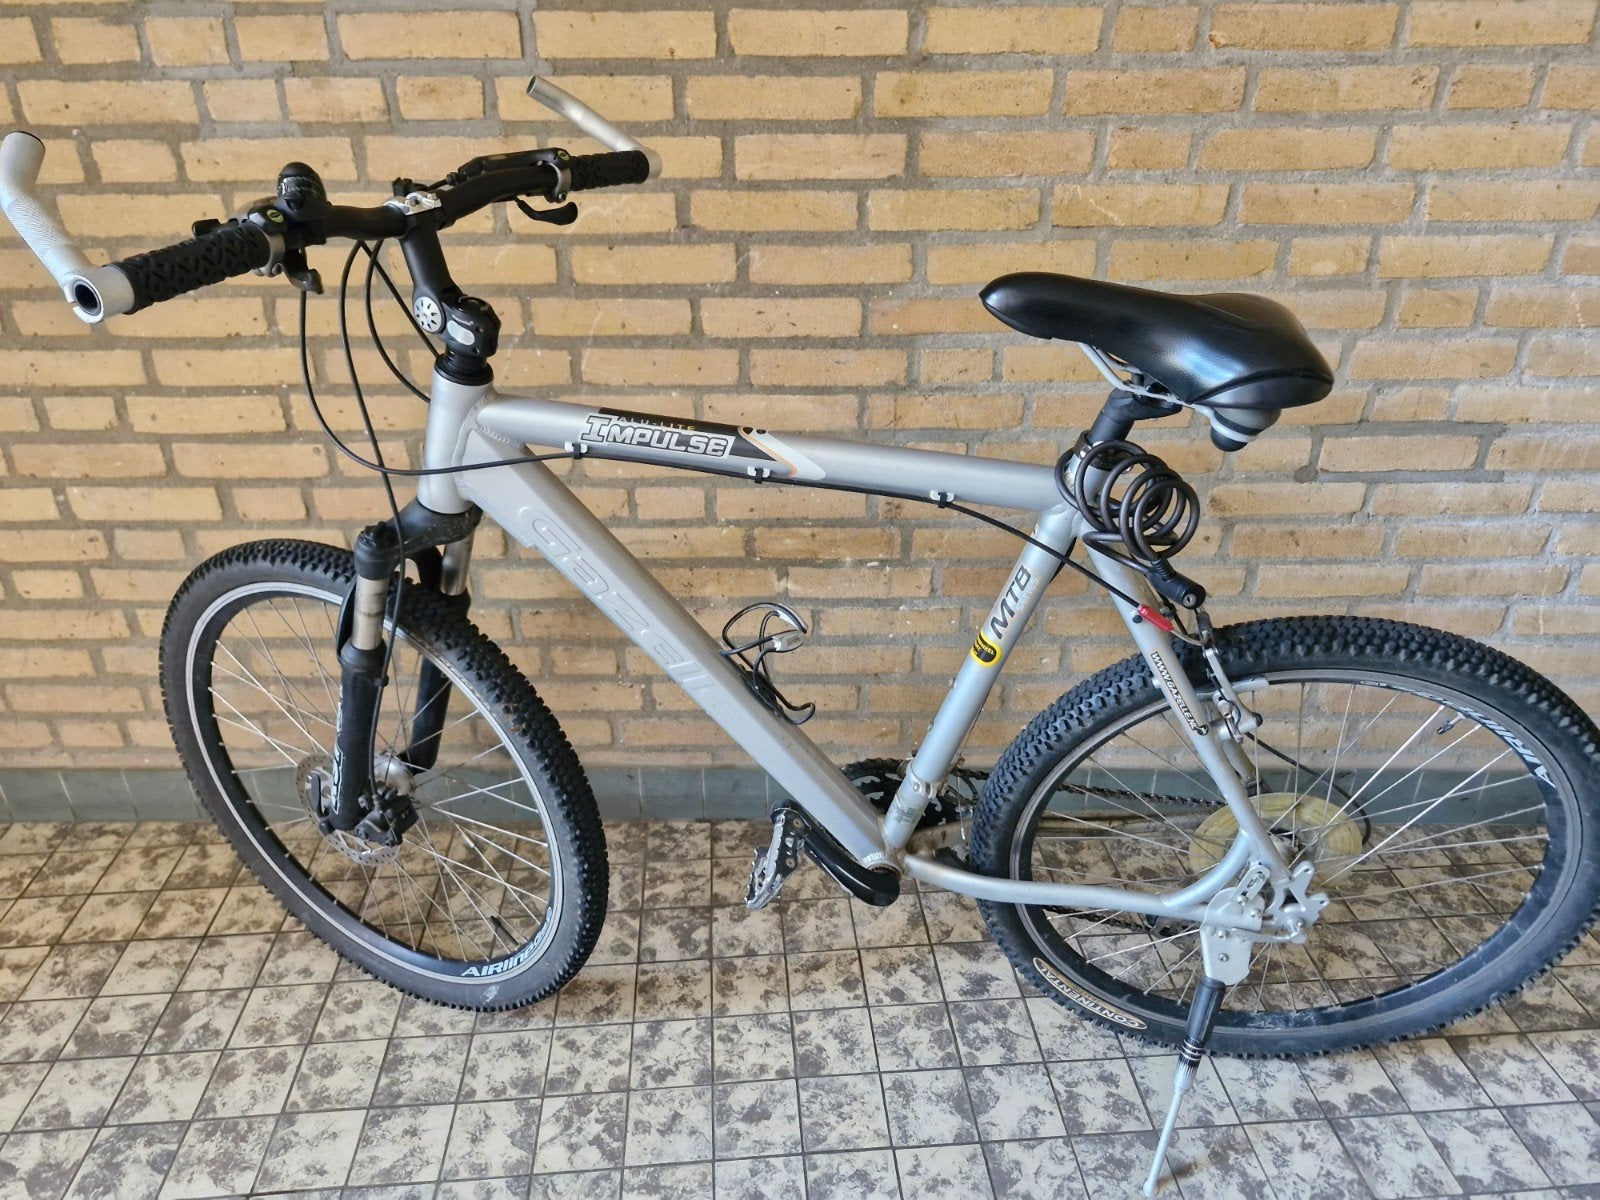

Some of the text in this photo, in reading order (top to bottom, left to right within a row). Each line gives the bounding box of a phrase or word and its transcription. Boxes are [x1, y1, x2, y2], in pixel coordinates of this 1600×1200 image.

[580, 413, 731, 459] IMPULSE
[990, 564, 1032, 640] MTB
[1041, 964, 1139, 1028] CONTINENTAL
